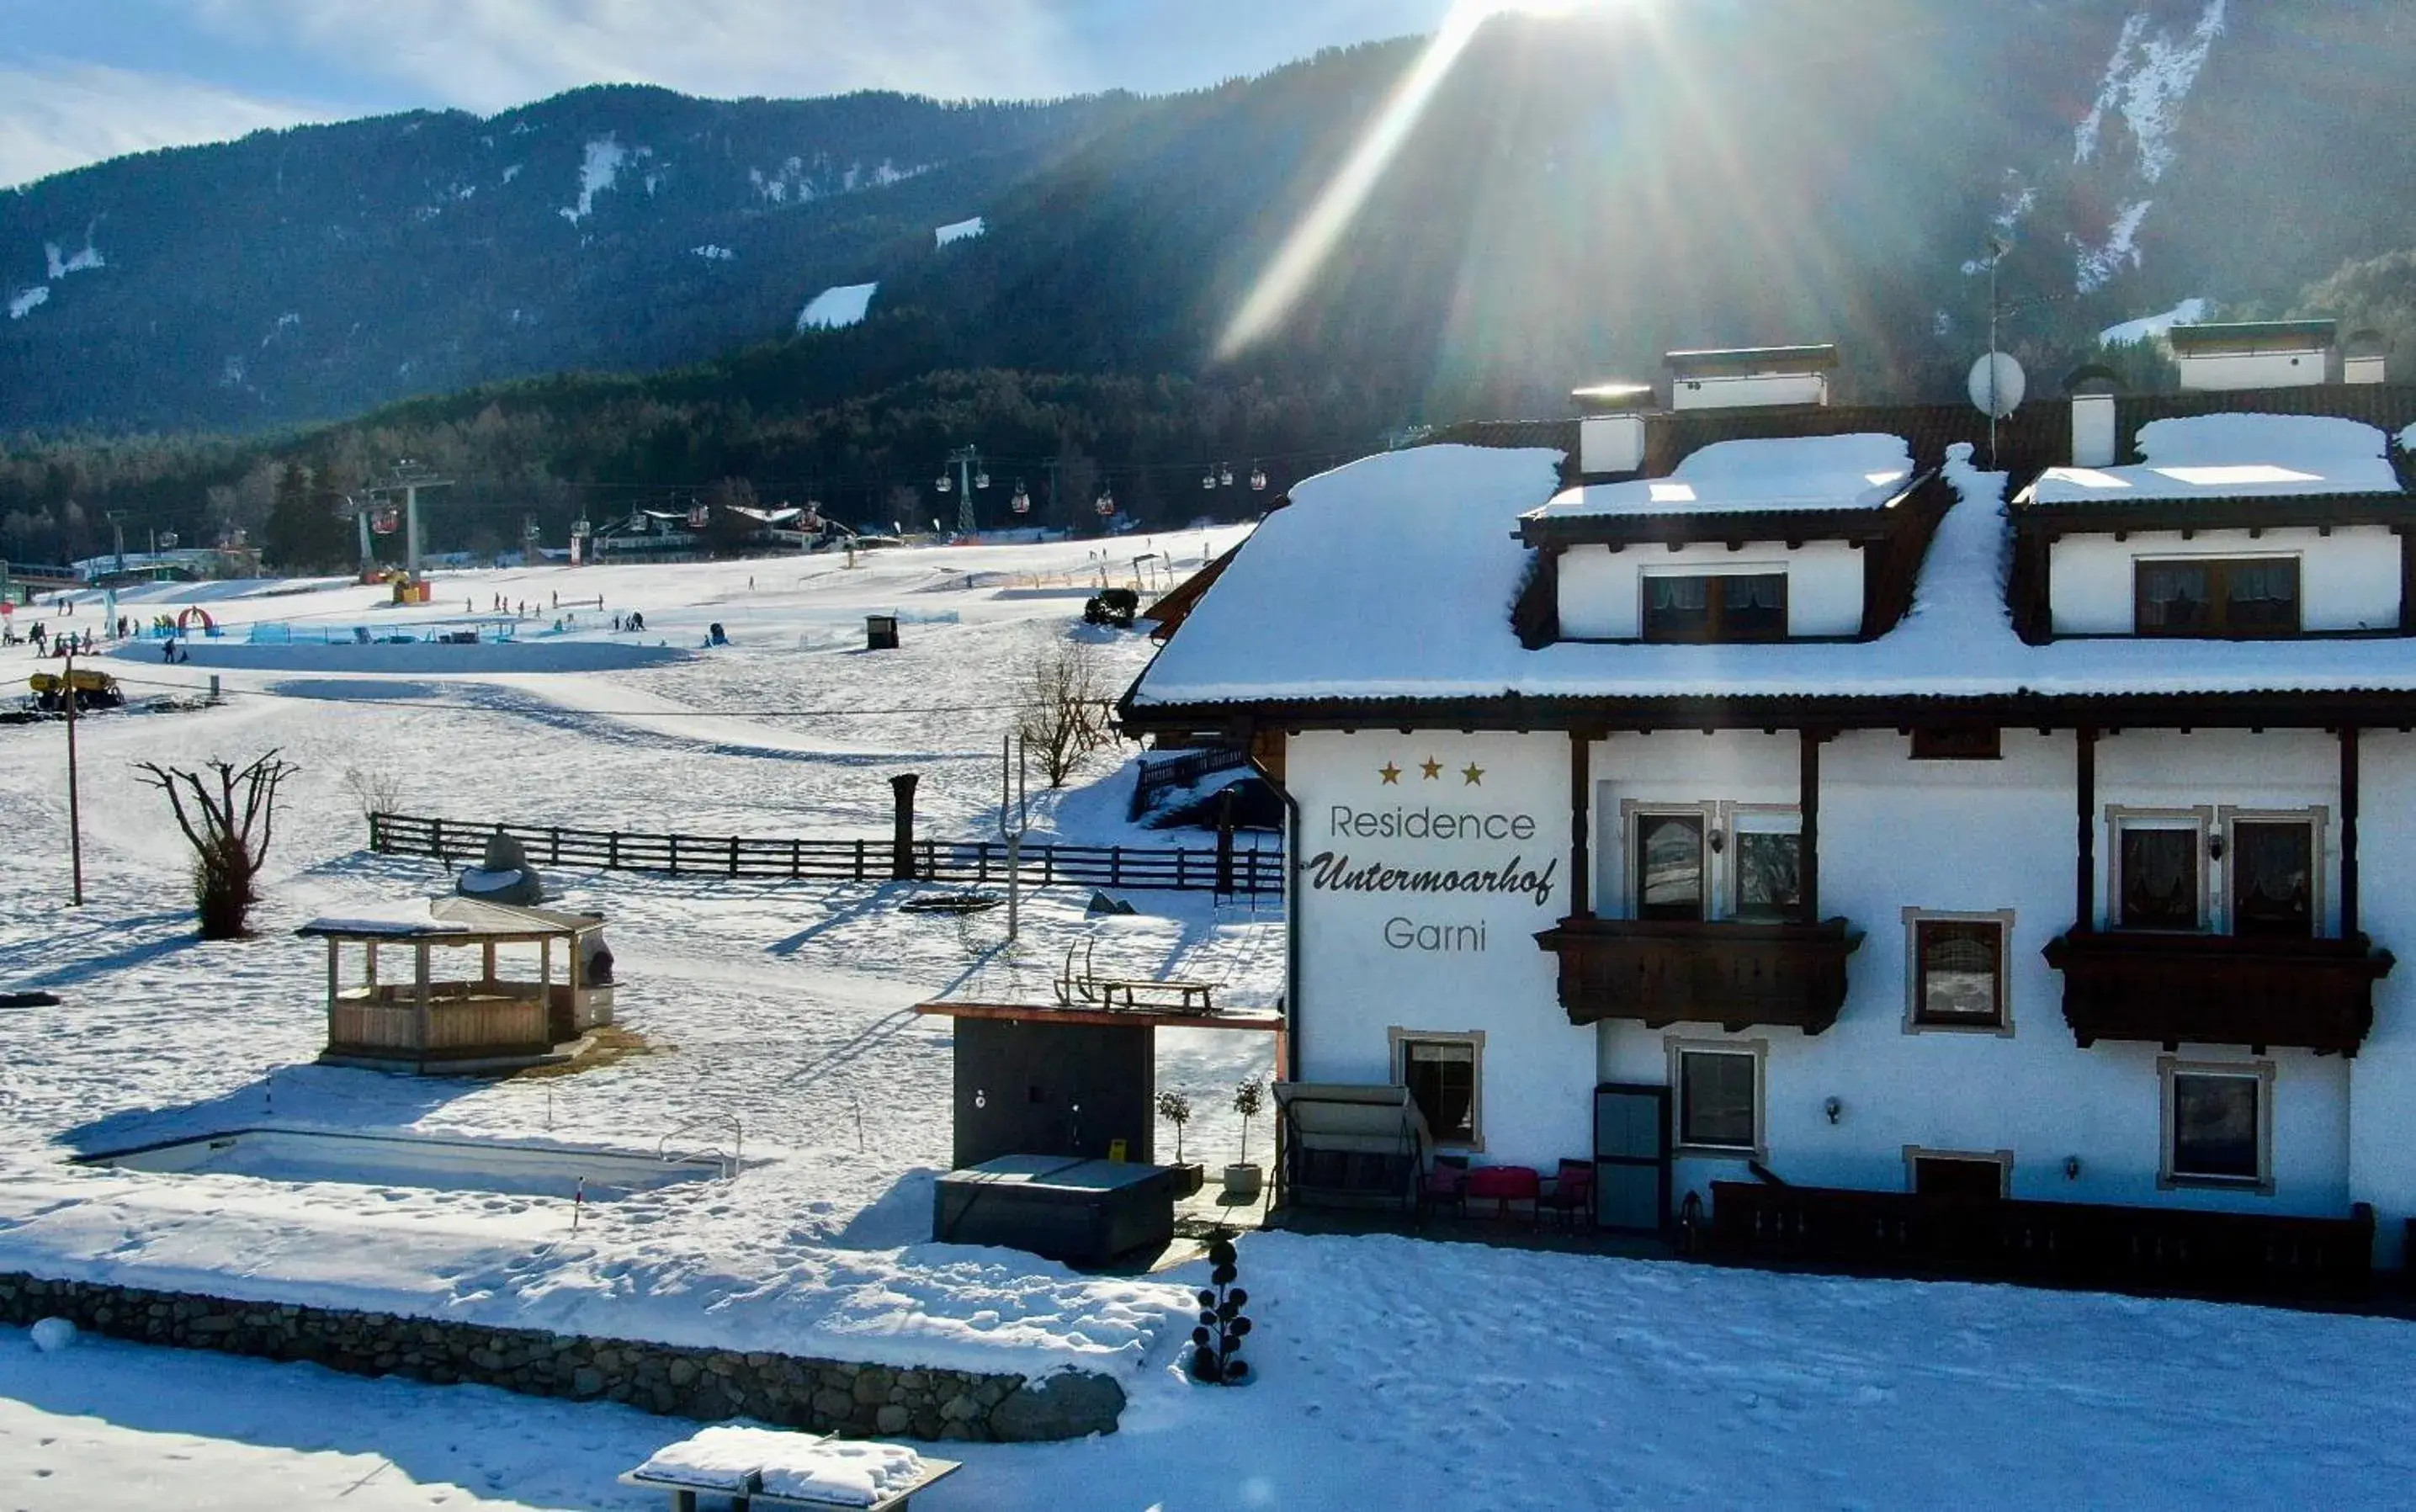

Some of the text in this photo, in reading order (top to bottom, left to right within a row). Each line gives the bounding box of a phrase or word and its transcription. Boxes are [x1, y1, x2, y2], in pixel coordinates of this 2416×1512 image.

[1330, 805, 1536, 840] Residence
[1306, 851, 1558, 907] Untermoarhof
[1383, 917, 1486, 951] Garni
